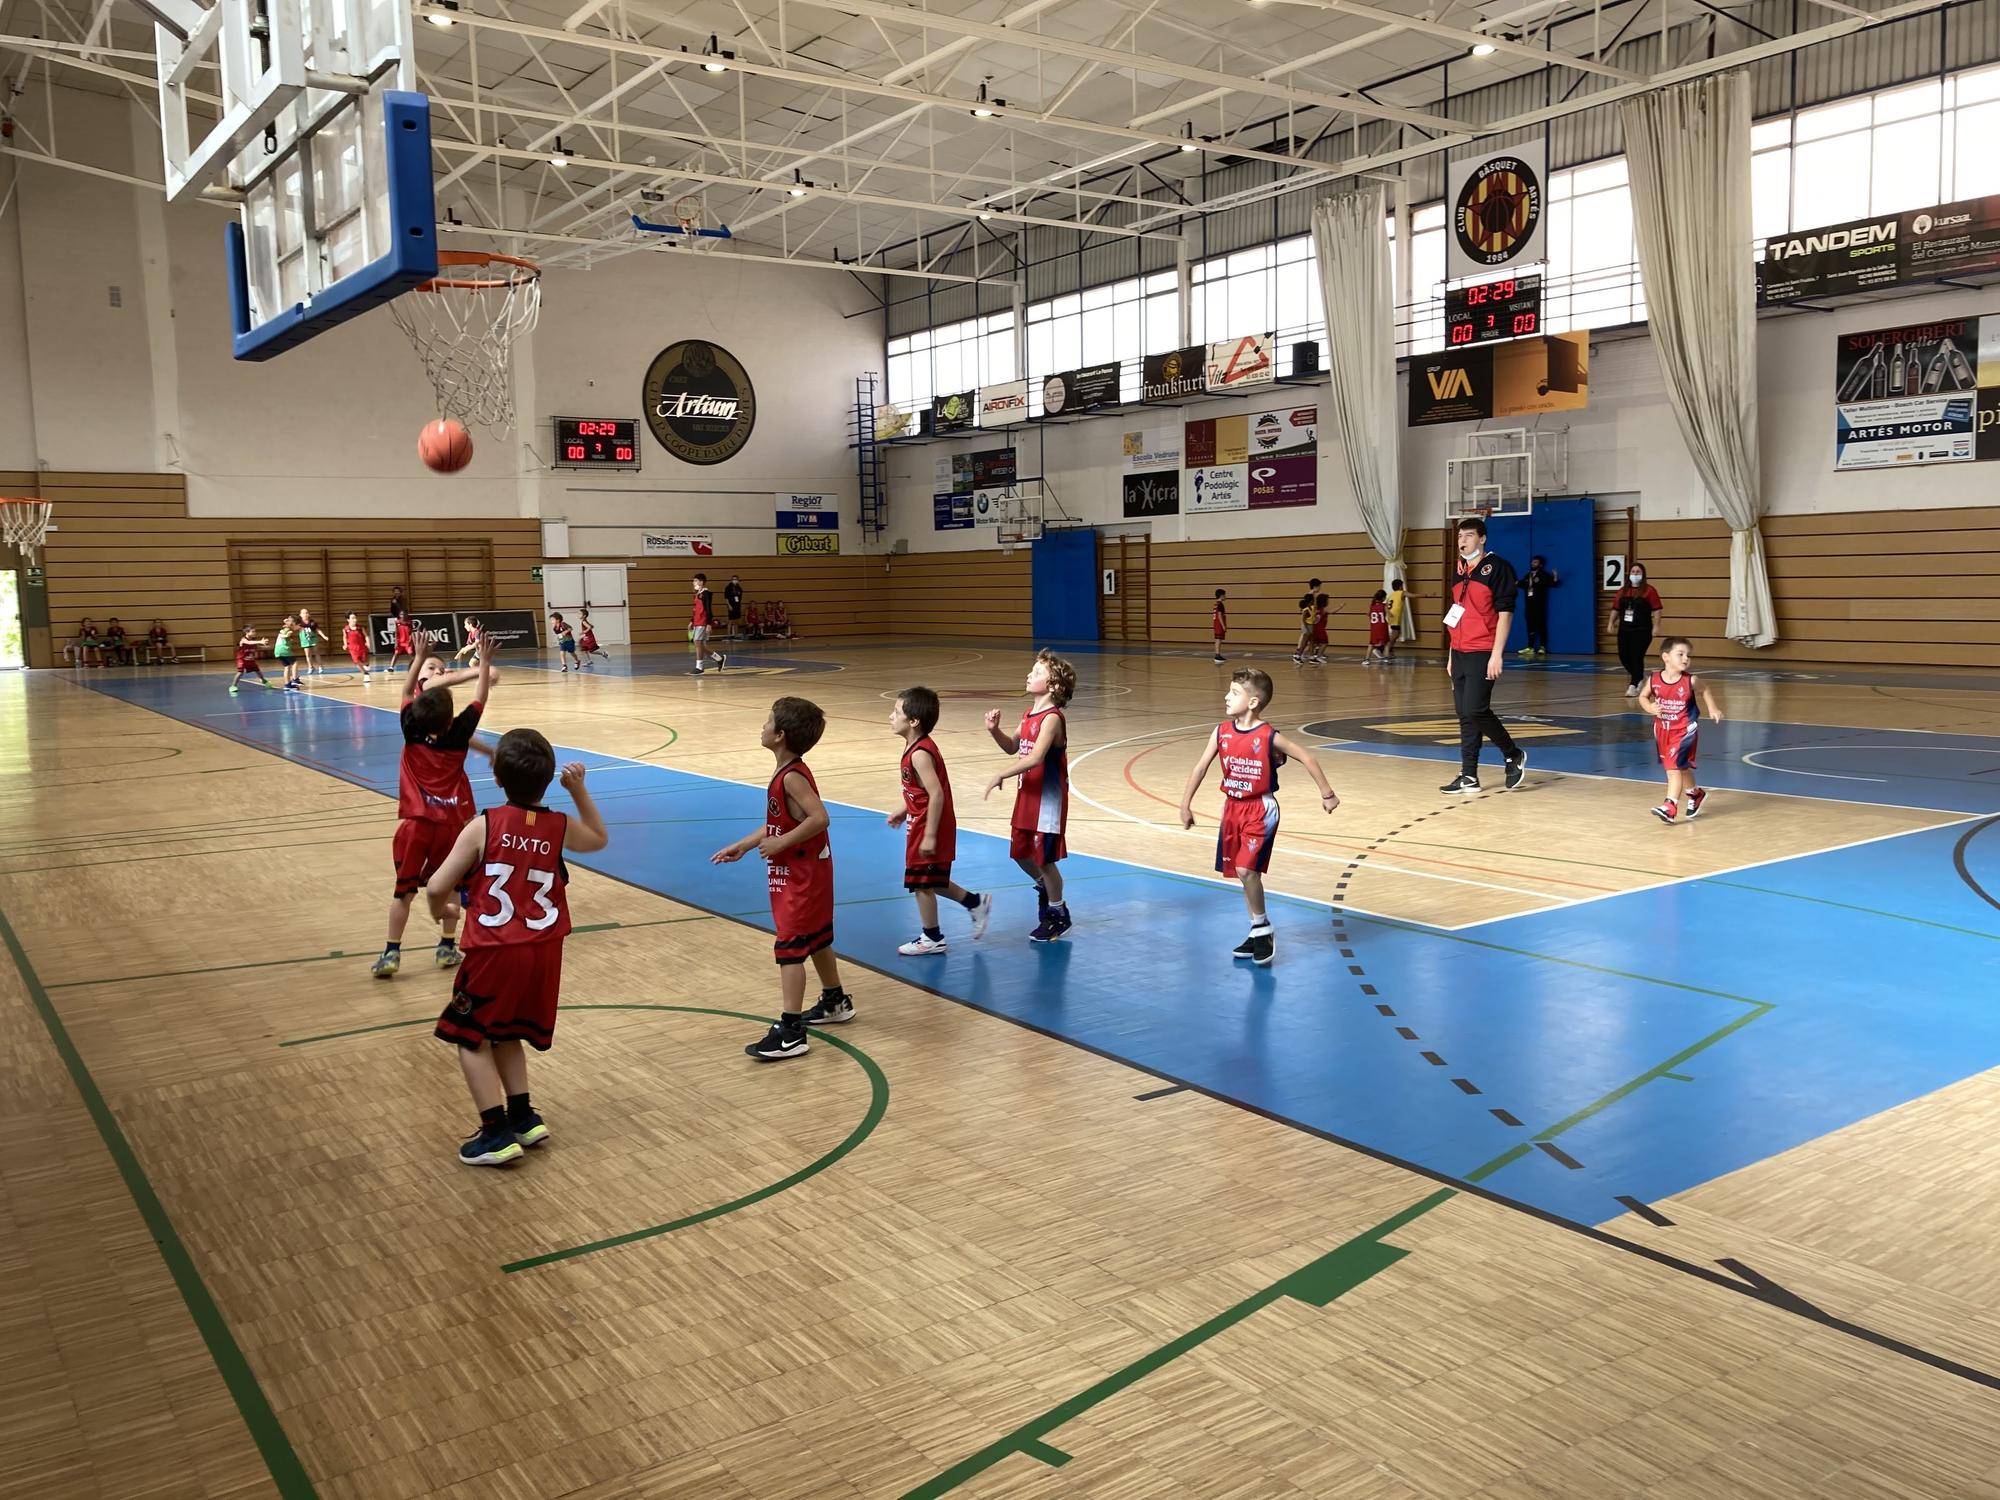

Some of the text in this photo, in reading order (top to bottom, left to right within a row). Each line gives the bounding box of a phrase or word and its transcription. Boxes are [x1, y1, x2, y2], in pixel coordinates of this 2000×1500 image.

[1478, 160, 1518, 179] BÀSQUET
[1528, 184, 1540, 220] ARTÉS
[1457, 205, 1466, 233] CLUB
[1769, 221, 1897, 261] TANDEM
[1850, 243, 1896, 258] SPORTS
[1923, 235, 1970, 249] Restaurant
[1486, 251, 1509, 263] 1984
[1926, 247, 1956, 258] Centre
[1958, 244, 1969, 252] de
[1468, 280, 1515, 305] 02:29
[1449, 311, 1472, 323] LOCAL
[1513, 313, 1536, 333] 00
[1452, 324, 1473, 343] 00
[1905, 336, 1940, 350] celler
[1143, 374, 1205, 399] frankfurt
[1427, 368, 1473, 400] VIA
[657, 392, 743, 420] Artium
[579, 422, 616, 436] 02:29
[1848, 421, 1953, 440] ARTÉS MOTOR
[568, 446, 584, 459] 00
[616, 447, 632, 460] 00
[1210, 470, 1233, 479] Centre
[792, 495, 822, 508] Regió7
[1125, 485, 1136, 503] la
[786, 533, 832, 552] Gibert
[1106, 572, 1112, 591] 1
[1606, 559, 1622, 587] 2
[1370, 612, 1385, 623] 81
[1230, 765, 1261, 775] Occident
[502, 834, 551, 855] SIXTO
[478, 863, 559, 931] 33
